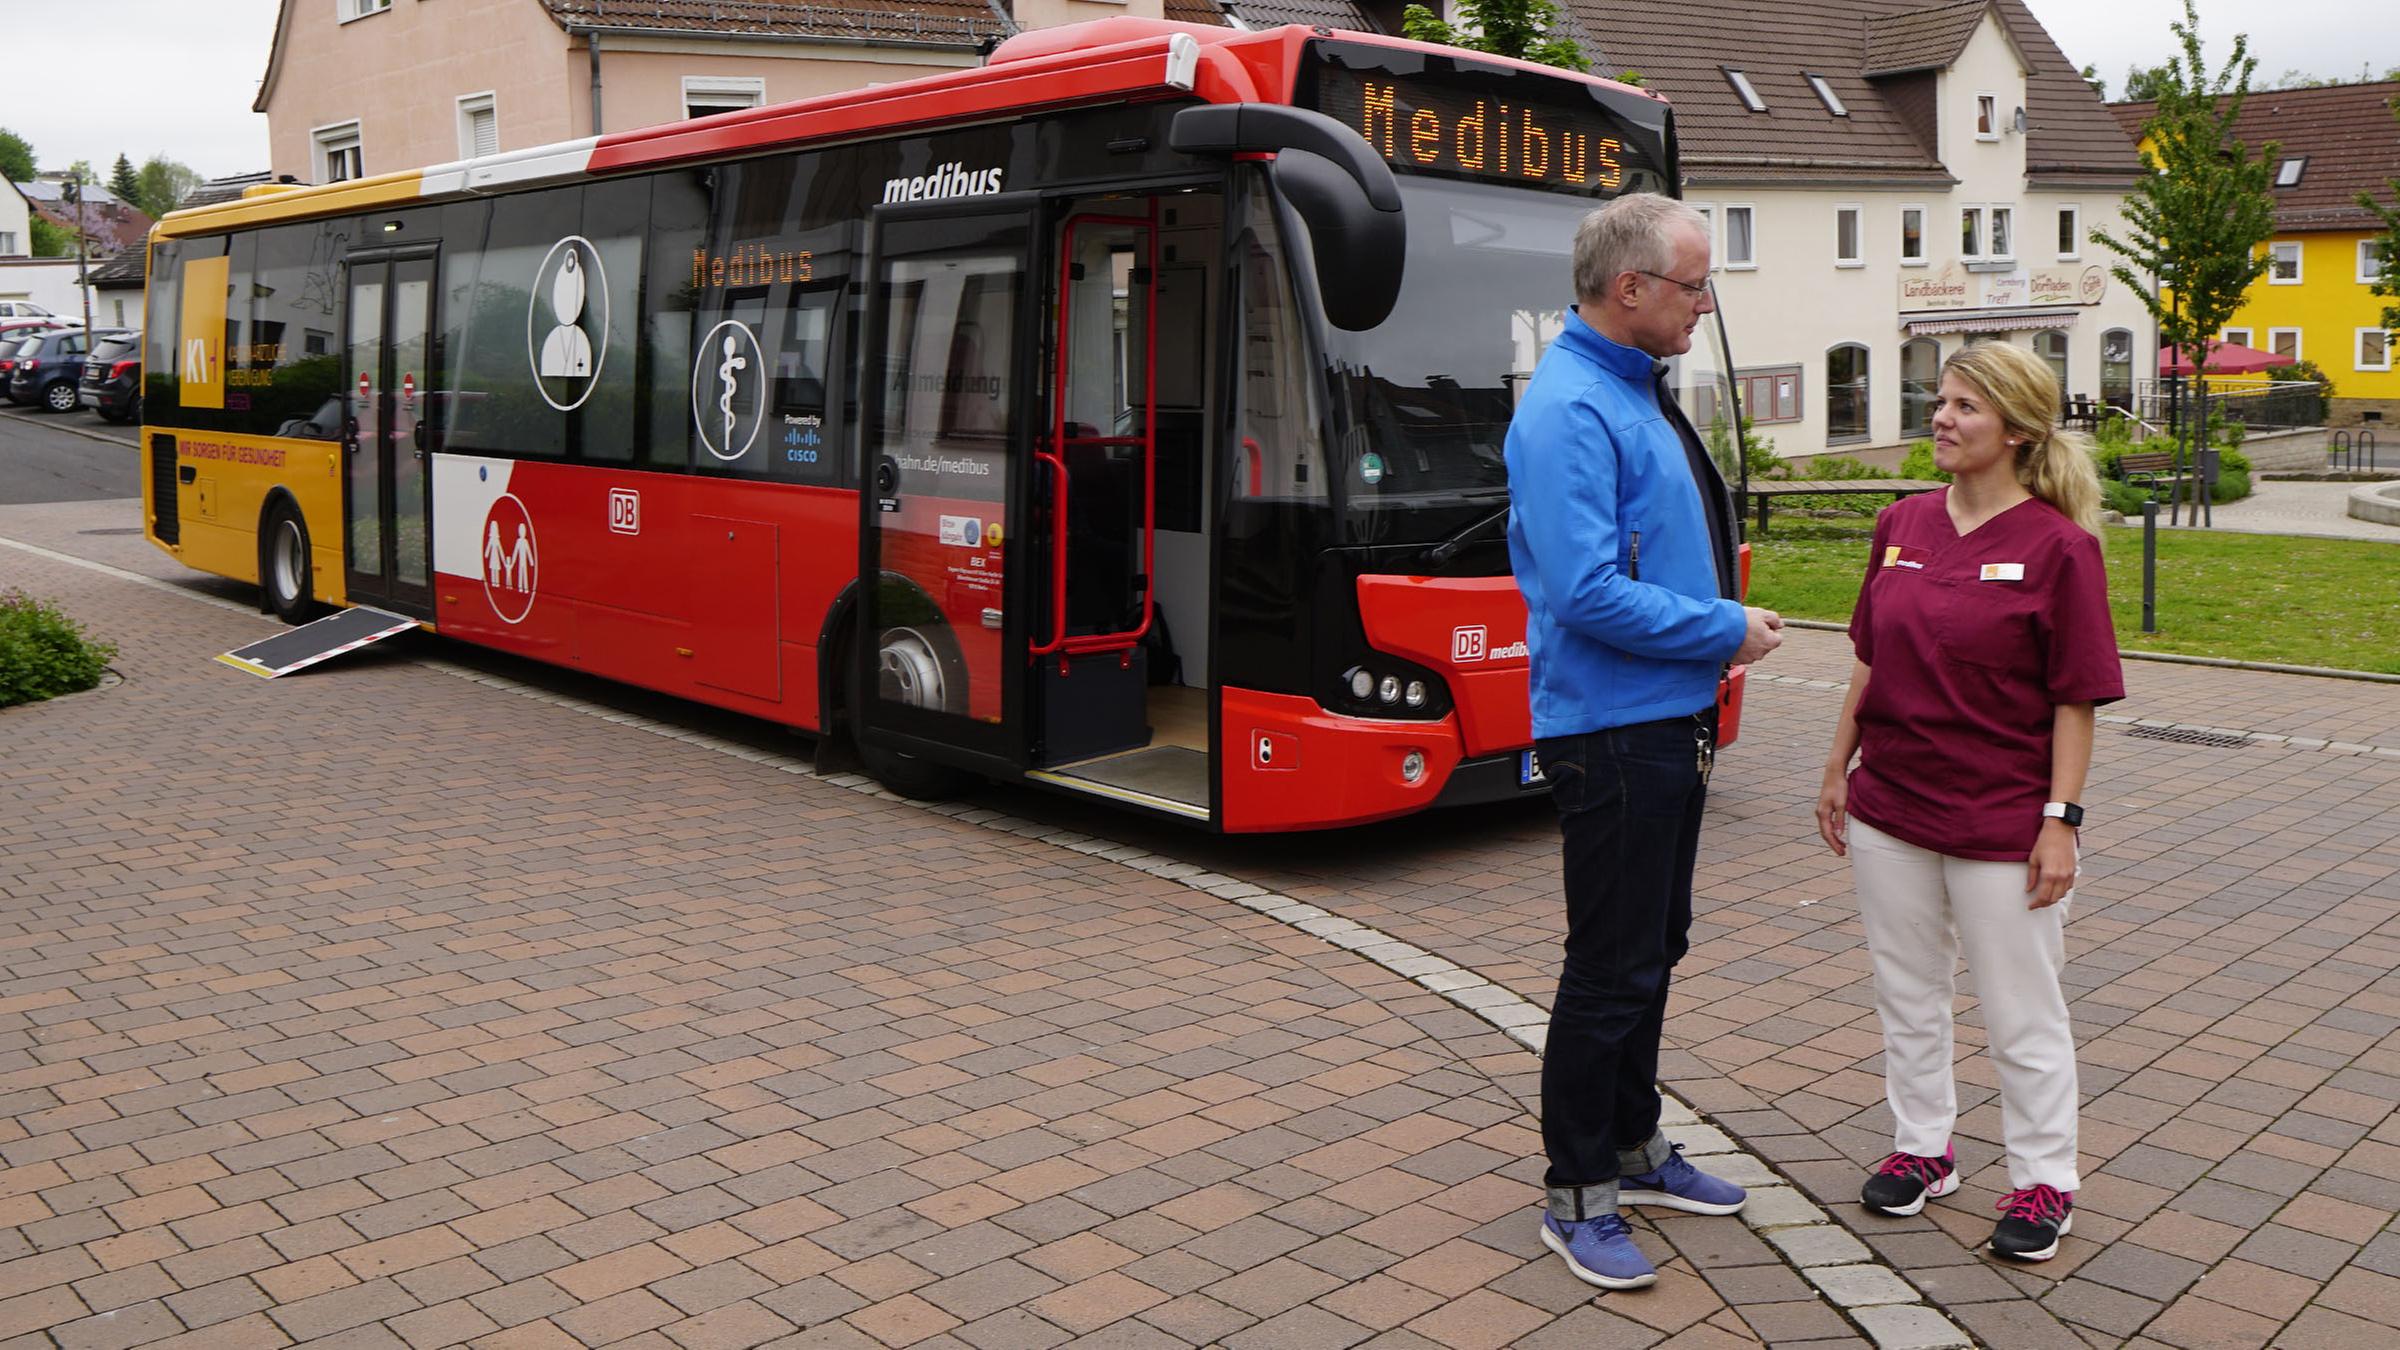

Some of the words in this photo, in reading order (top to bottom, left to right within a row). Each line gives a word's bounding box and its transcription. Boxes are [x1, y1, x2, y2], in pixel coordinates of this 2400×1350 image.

[1363, 82, 1621, 188] Medibus
[883, 161, 1003, 205] medibus
[692, 243, 813, 288] Medibus
[1904, 280, 1966, 298] Landbäckerei
[1985, 292, 2012, 305] Treff
[193, 442, 220, 460] SORGEN
[222, 441, 237, 462] FÜR
[239, 446, 286, 468] GESUNDHEIT
[613, 494, 636, 528] DB
[1456, 630, 1483, 658] DB
